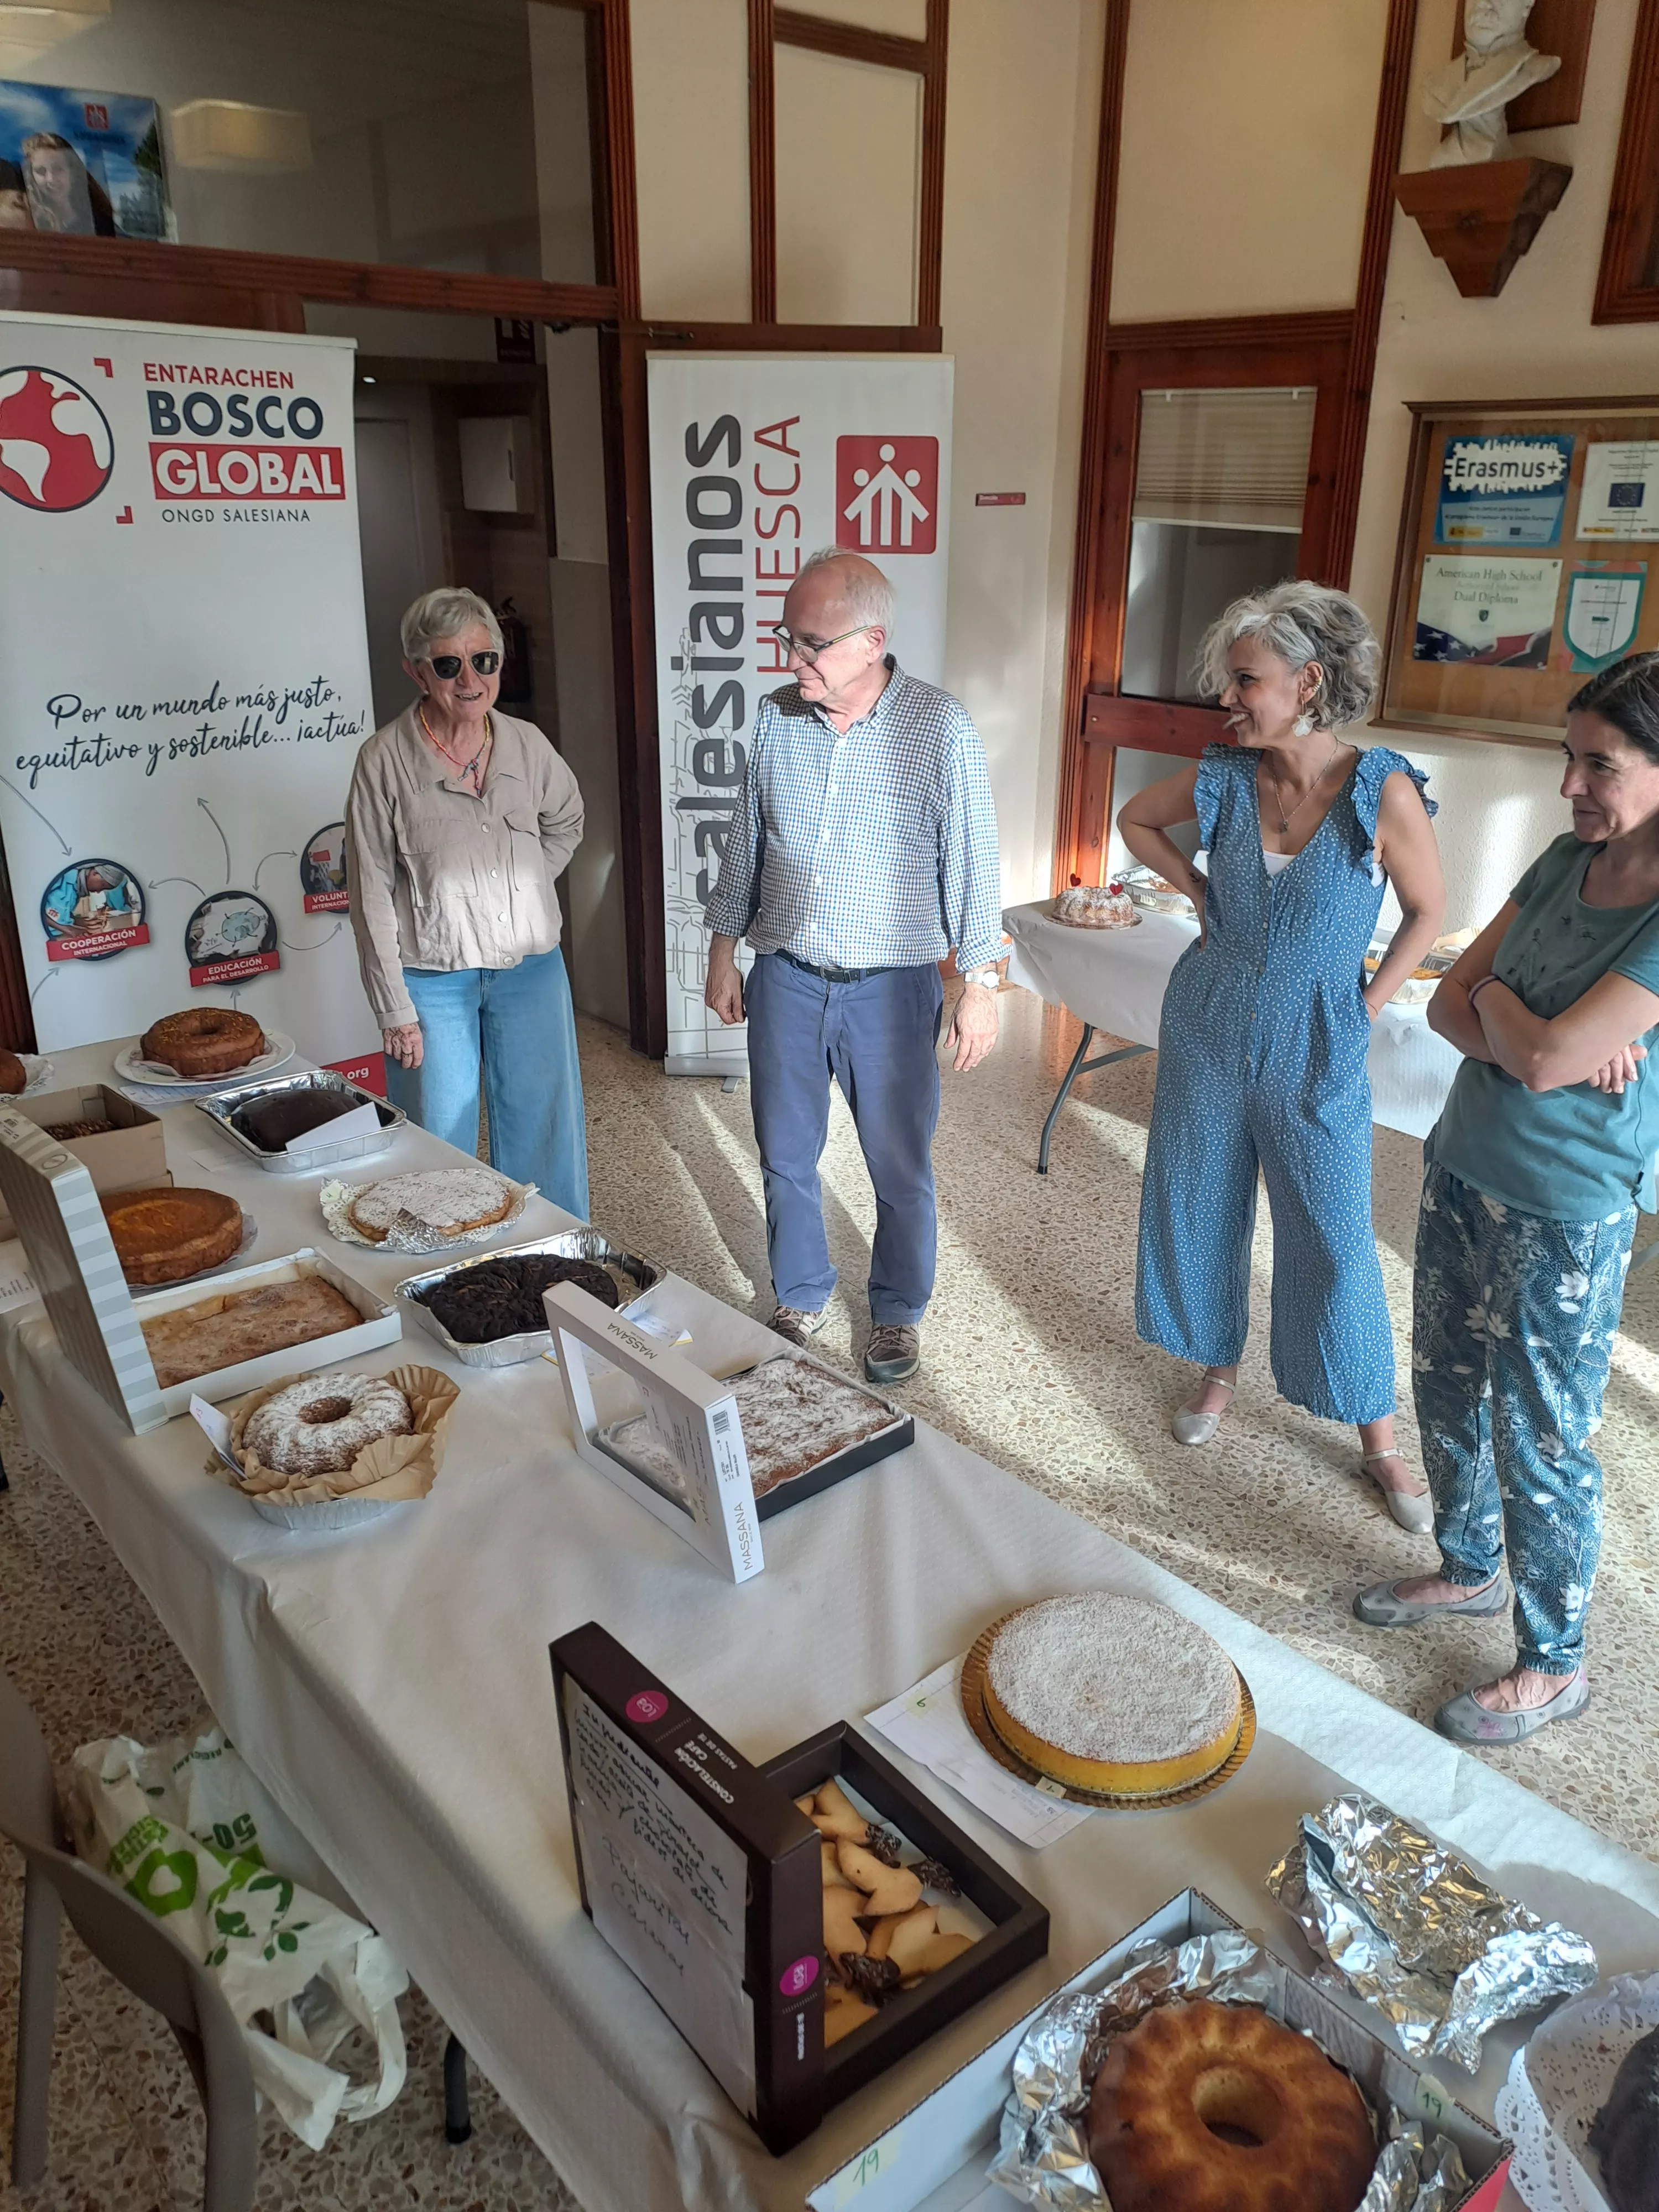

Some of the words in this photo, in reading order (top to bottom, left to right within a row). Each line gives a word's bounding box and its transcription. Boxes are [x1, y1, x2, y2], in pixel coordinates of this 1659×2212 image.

[143, 363, 294, 389] ENTARACHEN
[147, 390, 324, 439] BOSCO
[155, 448, 341, 495] GLOBAL
[1454, 457, 1559, 478] Erasmus+
[162, 509, 215, 523] ONGD
[223, 509, 310, 523] SALESIANA
[1436, 567, 1480, 578] American
[1483, 568, 1506, 581] High
[1509, 570, 1543, 581] School
[1454, 591, 1476, 602] Dual
[1479, 591, 1519, 604] Diploma
[46, 693, 108, 729] Por
[116, 701, 147, 721] un
[152, 680, 230, 717] mundo
[235, 683, 279, 708] más
[275, 675, 342, 724] justo,
[15, 732, 143, 789] equitativo
[145, 743, 165, 776] y
[312, 891, 348, 904] VOLUNT
[61, 928, 136, 951] COOPERACIÓN
[74, 941, 128, 956] INTERNACIONAL
[202, 974, 220, 983] PARA
[229, 964, 269, 978] DESARROLLO
[208, 957, 263, 975] EDUCACIÓN
[347, 1067, 369, 1080] org
[607, 1322, 658, 1360] MASSANA
[734, 1501, 753, 1571] MASSANA
[684, 1740, 708, 1761] CAFÉ
[674, 1746, 734, 1804] CONSTELACIÓN
[1422, 2092, 1442, 2119] 19
[853, 2147, 879, 2187] 19
